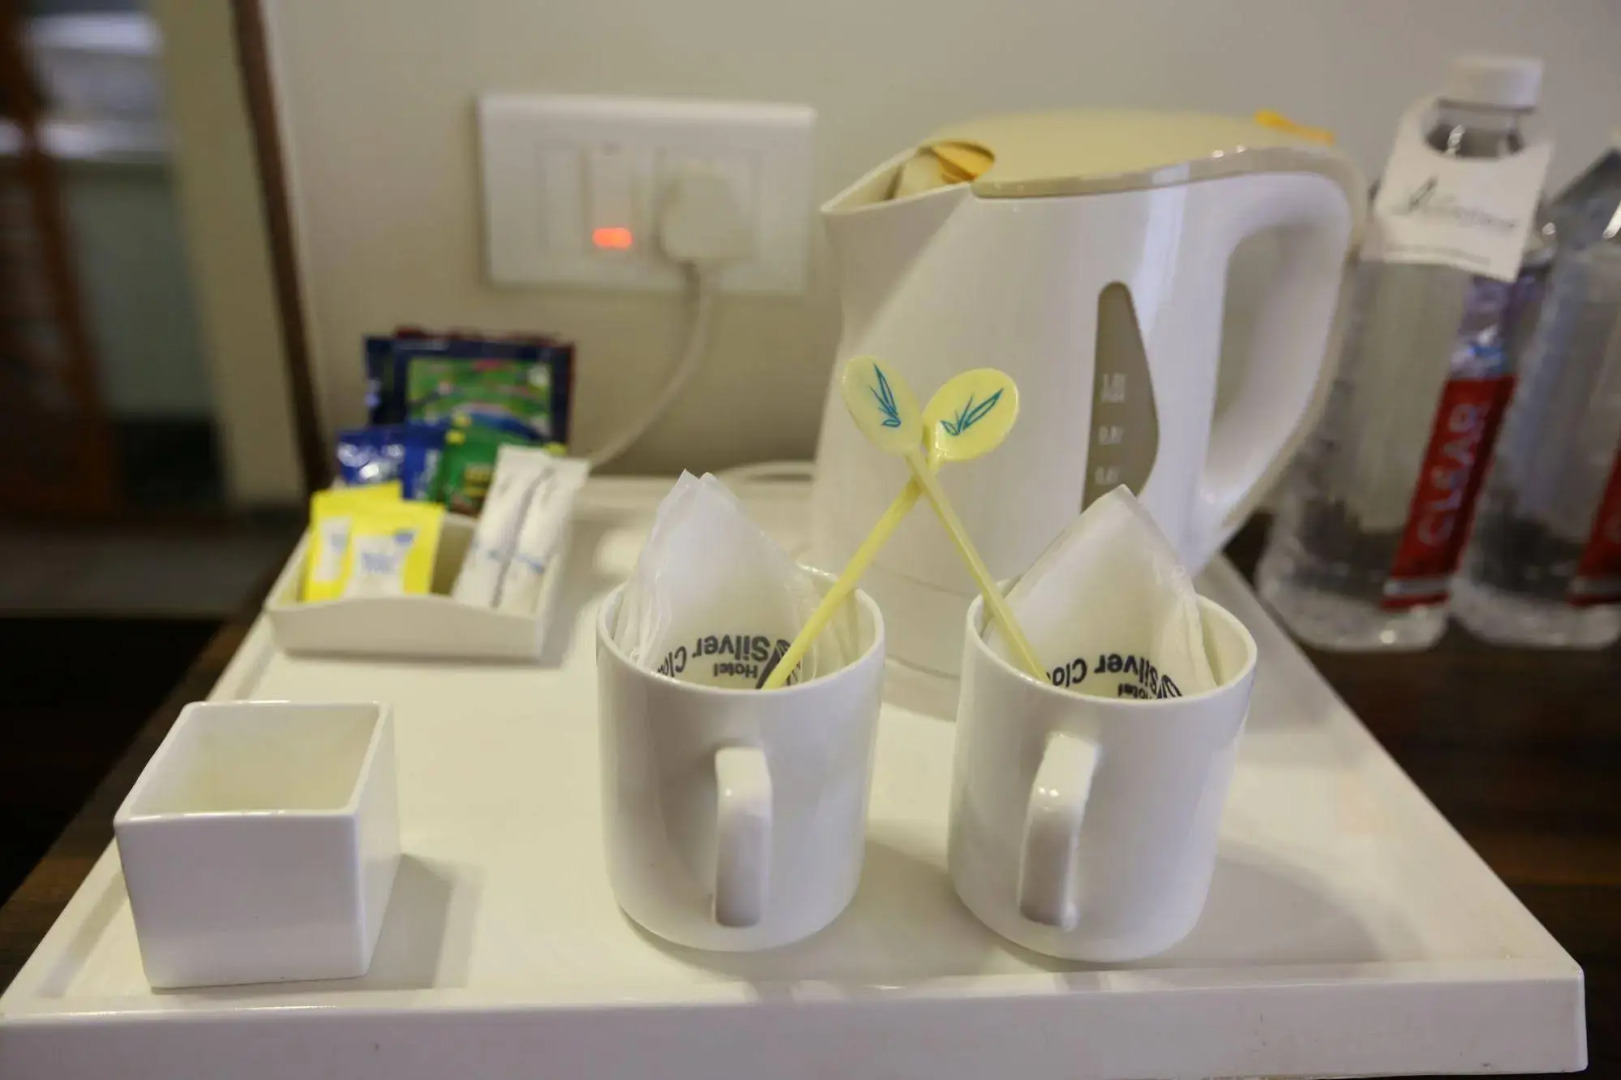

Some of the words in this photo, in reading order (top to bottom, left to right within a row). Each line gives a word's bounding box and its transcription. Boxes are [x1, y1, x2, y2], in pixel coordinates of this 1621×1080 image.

[691, 634, 770, 662] Silver
[713, 663, 758, 678] Hotel
[1046, 658, 1087, 687] Clo
[1093, 654, 1158, 694] Silver
